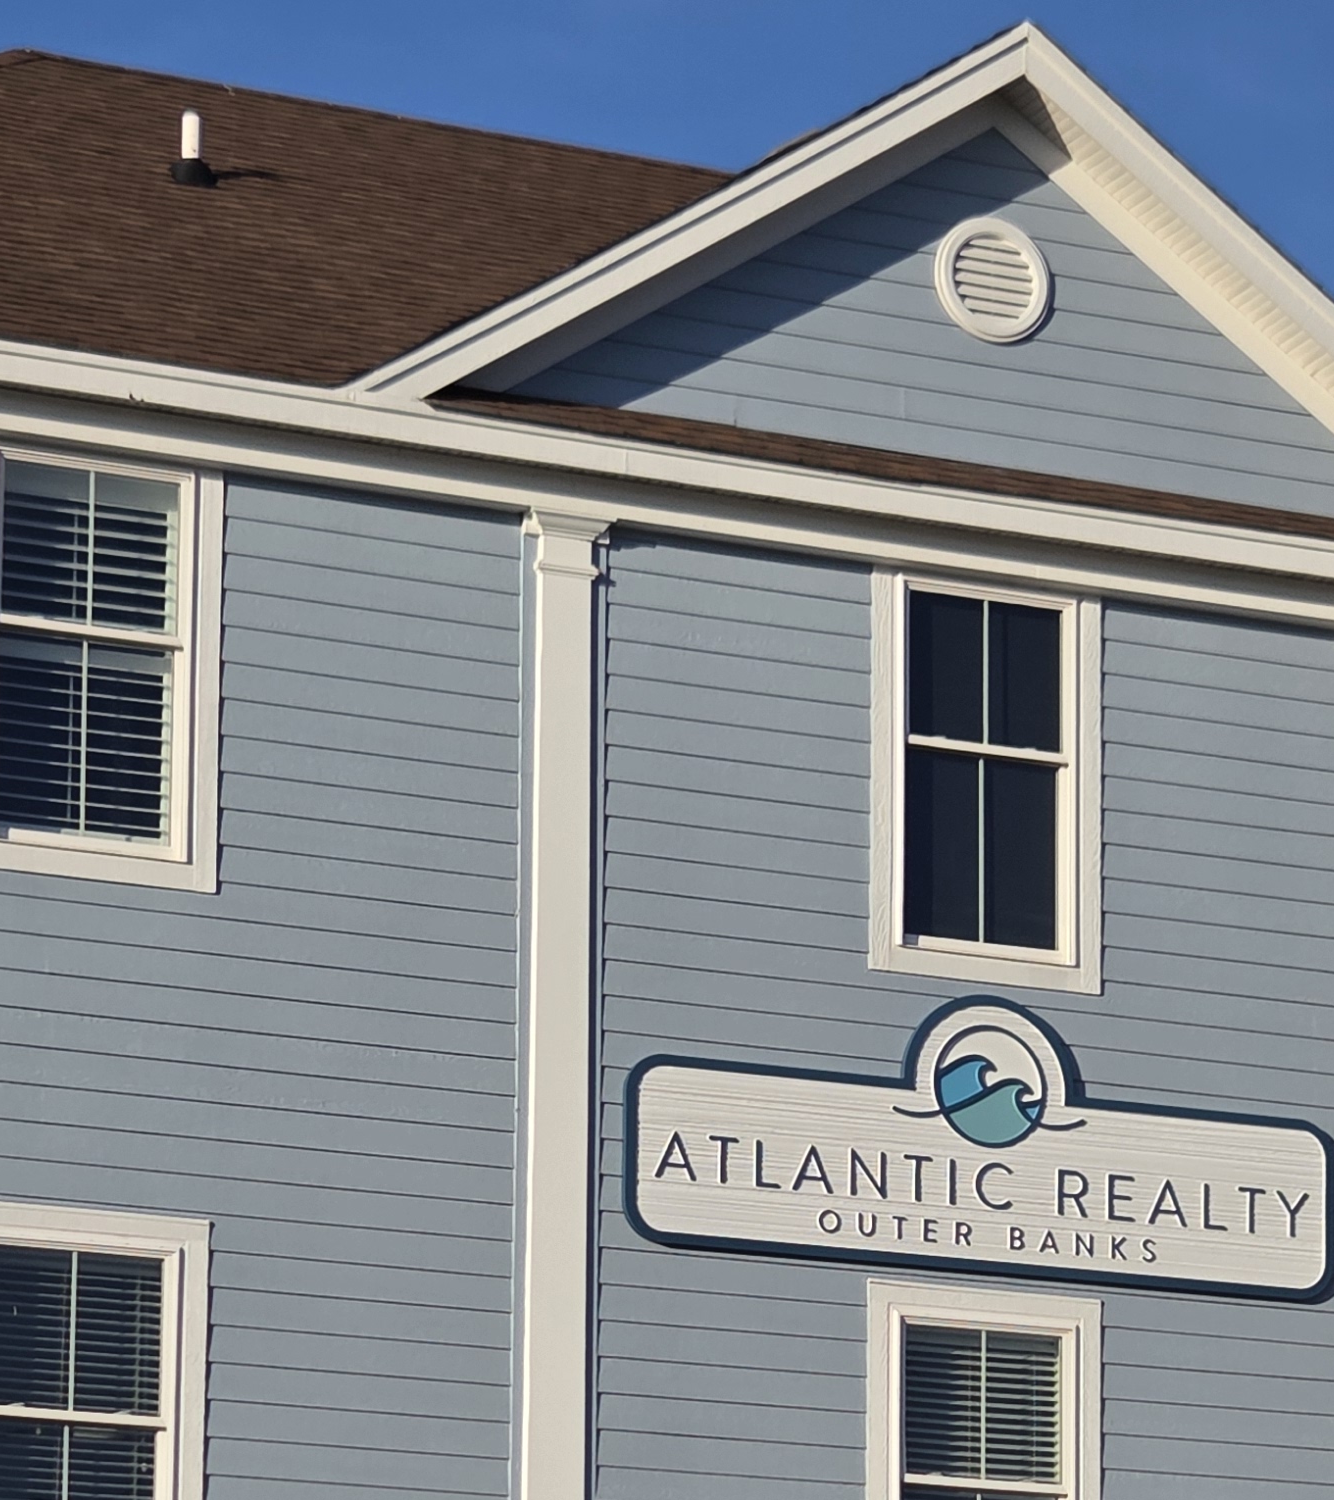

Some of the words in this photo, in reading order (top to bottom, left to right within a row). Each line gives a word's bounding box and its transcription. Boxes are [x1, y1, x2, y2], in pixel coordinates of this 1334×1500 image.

[654, 1130, 1014, 1212] ATLANTIC
[1055, 1167, 1310, 1239] REALTY
[818, 1208, 973, 1247] OUTER
[1008, 1226, 1158, 1264] BANKS
